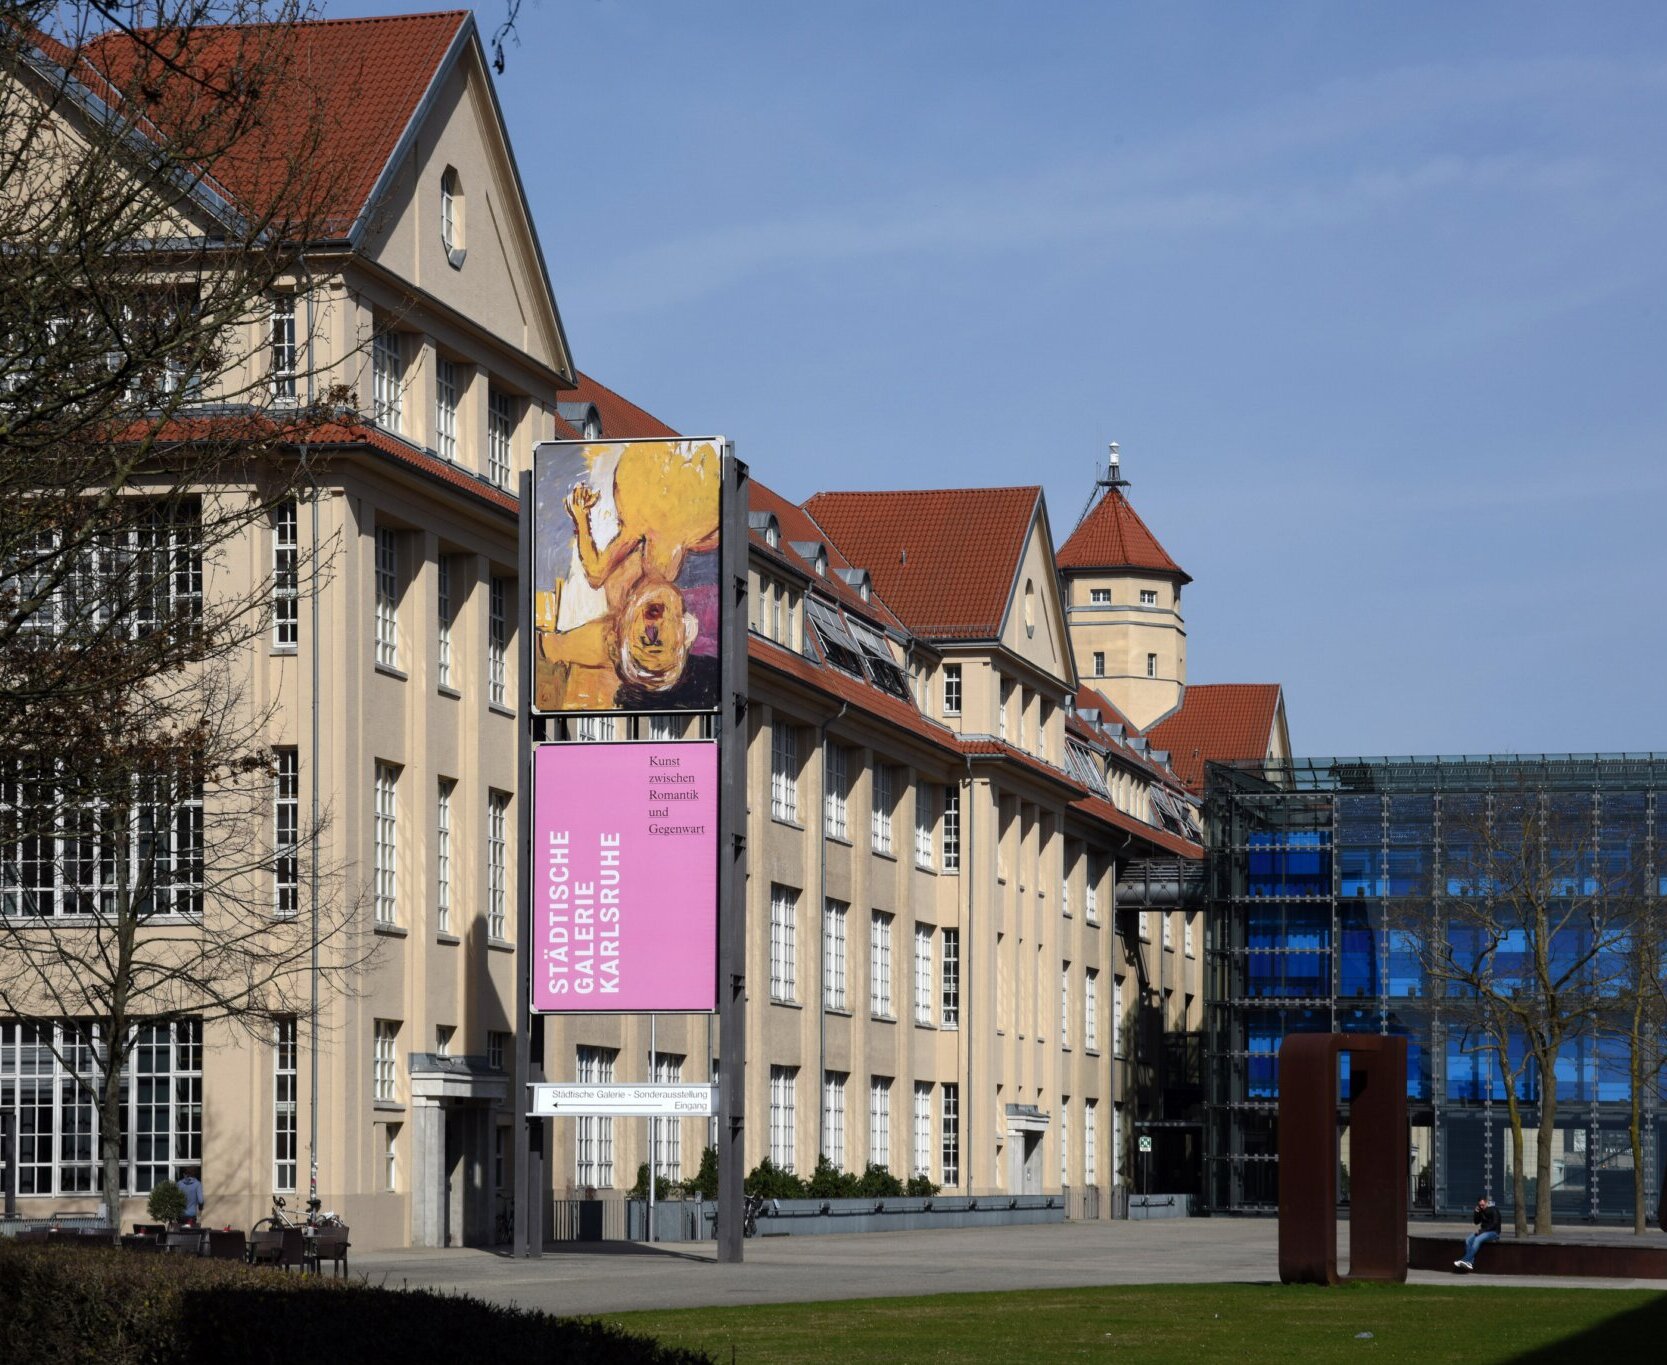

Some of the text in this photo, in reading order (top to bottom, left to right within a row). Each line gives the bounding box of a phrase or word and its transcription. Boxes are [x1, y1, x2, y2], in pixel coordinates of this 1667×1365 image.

[649, 756, 680, 767] Kunst
[649, 773, 695, 783] zwischen
[649, 789, 699, 800] Romantik
[648, 807, 669, 817] und
[648, 824, 705, 836] Gegenwart
[543, 830, 569, 995] STÄDTISCHE
[599, 832, 620, 993] KARLSRUHE
[574, 881, 594, 995] GALERIE
[552, 1089, 594, 1099] Städtische
[597, 1089, 625, 1099] Galerie
[633, 1089, 708, 1100] Sonderausstellung
[674, 1101, 708, 1112] Eingang
